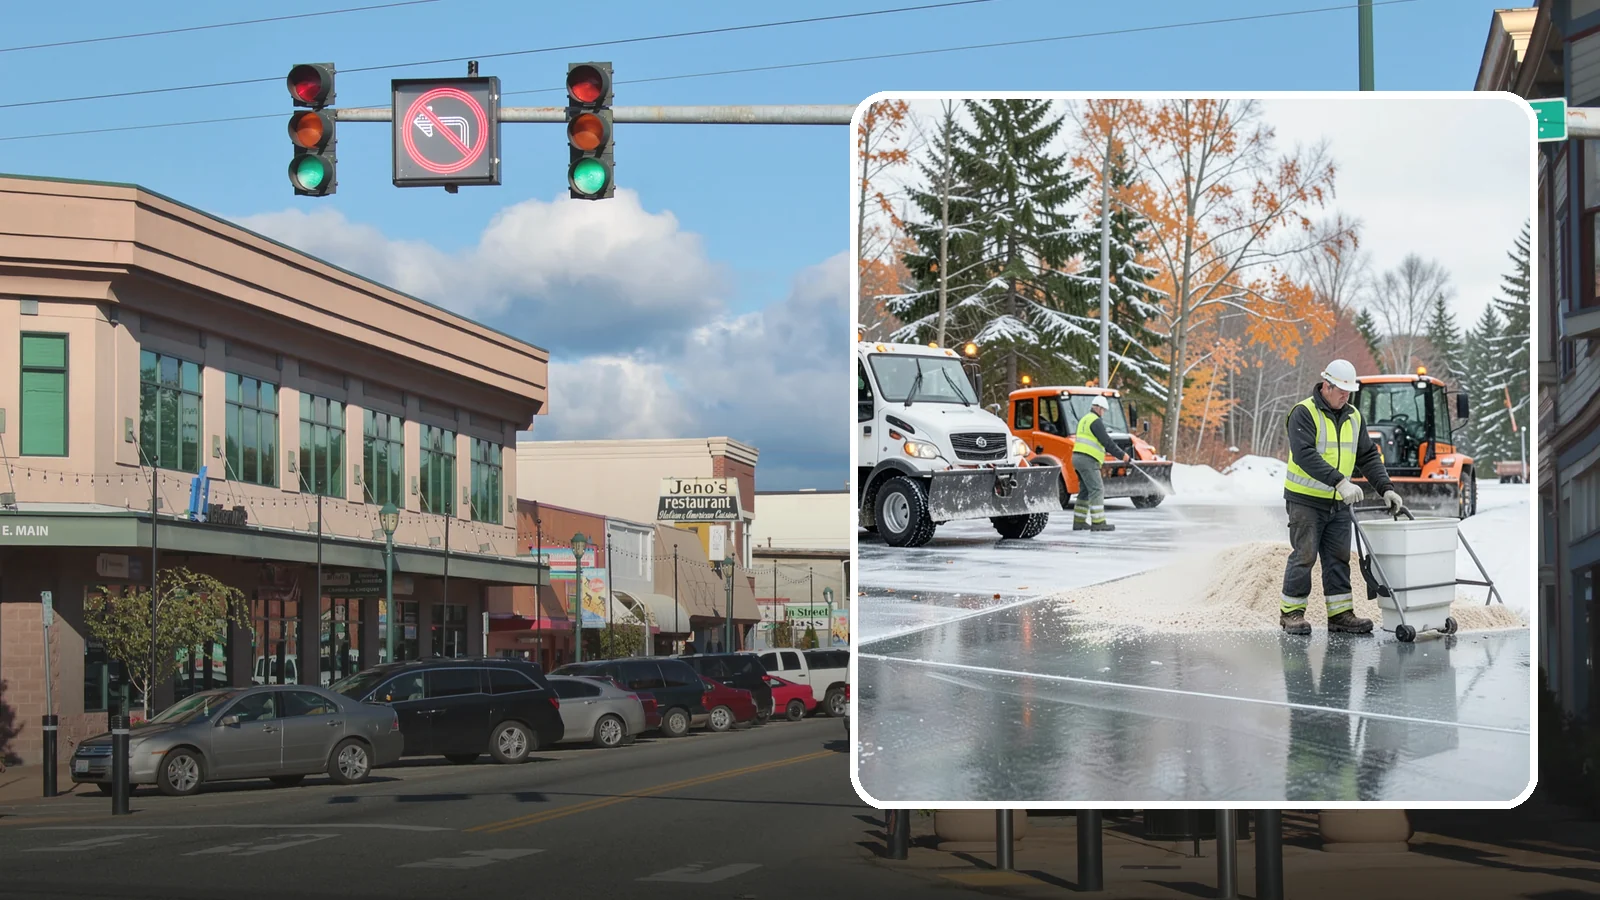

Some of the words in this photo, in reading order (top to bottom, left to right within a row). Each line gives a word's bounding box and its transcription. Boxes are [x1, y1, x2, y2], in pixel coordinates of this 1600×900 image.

[670, 480, 727, 494] Jeno's
[665, 496, 731, 509] restaurant
[658, 510, 681, 519] Italian
[685, 510, 715, 519] American
[715, 509, 737, 519] Cuisine
[2, 525, 13, 536] E.
[15, 525, 49, 536] MAIN
[797, 607, 828, 617] Street
